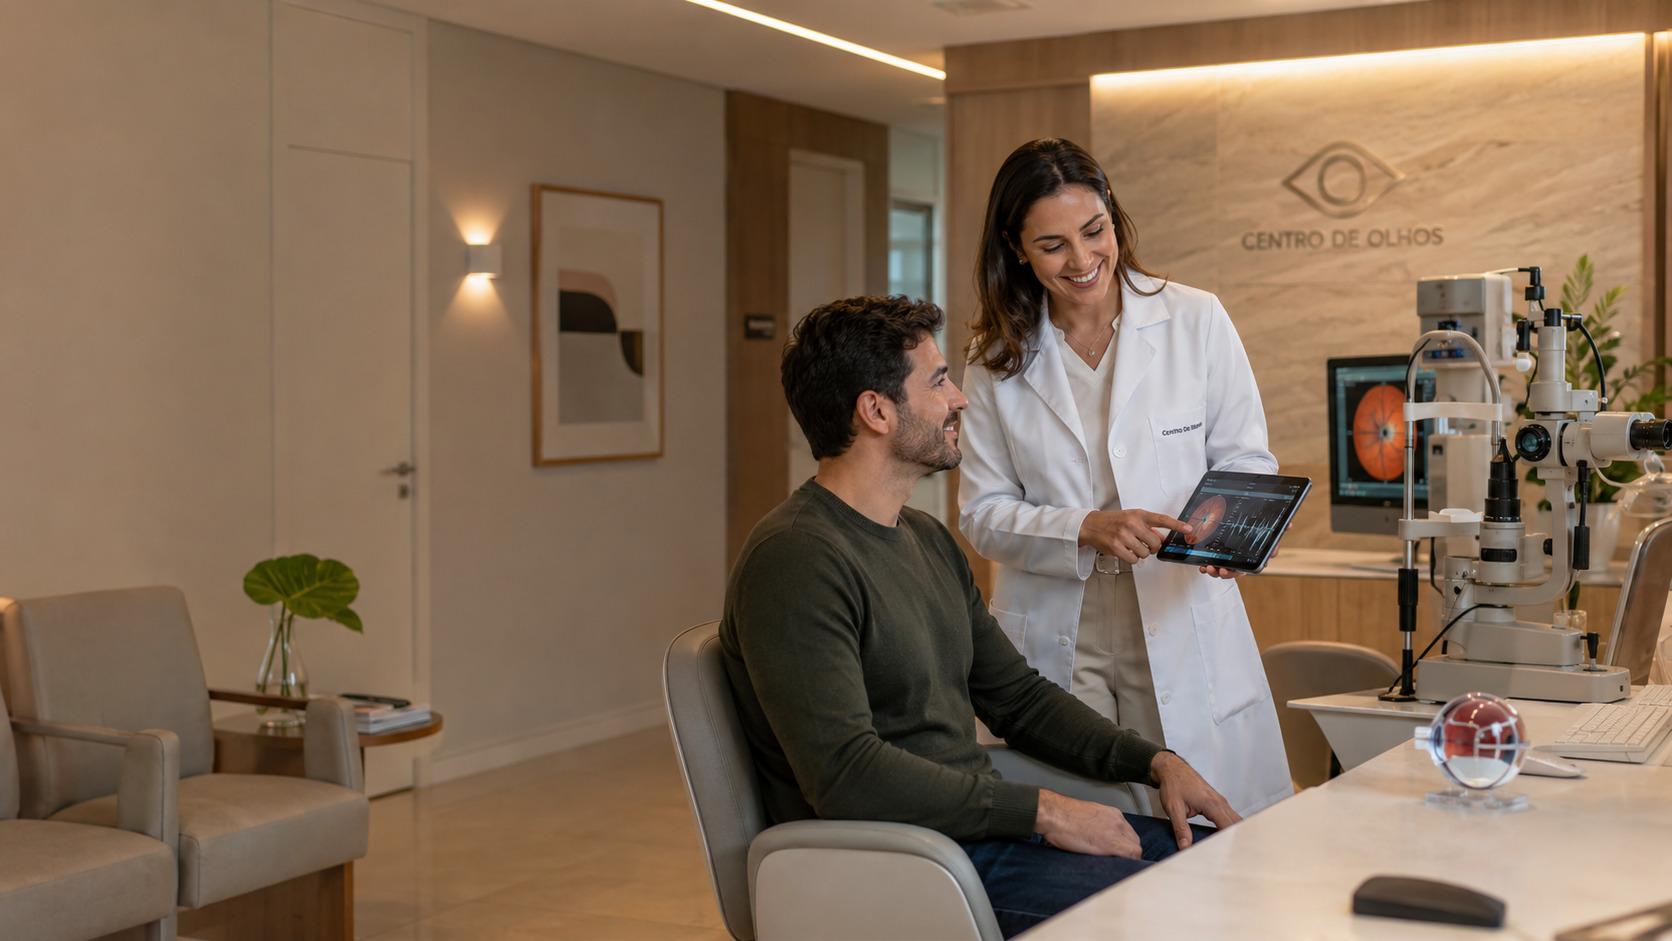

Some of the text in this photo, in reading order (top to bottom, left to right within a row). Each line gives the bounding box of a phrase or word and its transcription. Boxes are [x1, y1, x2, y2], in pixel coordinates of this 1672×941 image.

[1241, 227, 1444, 250] CENTRO DE OLHOS
